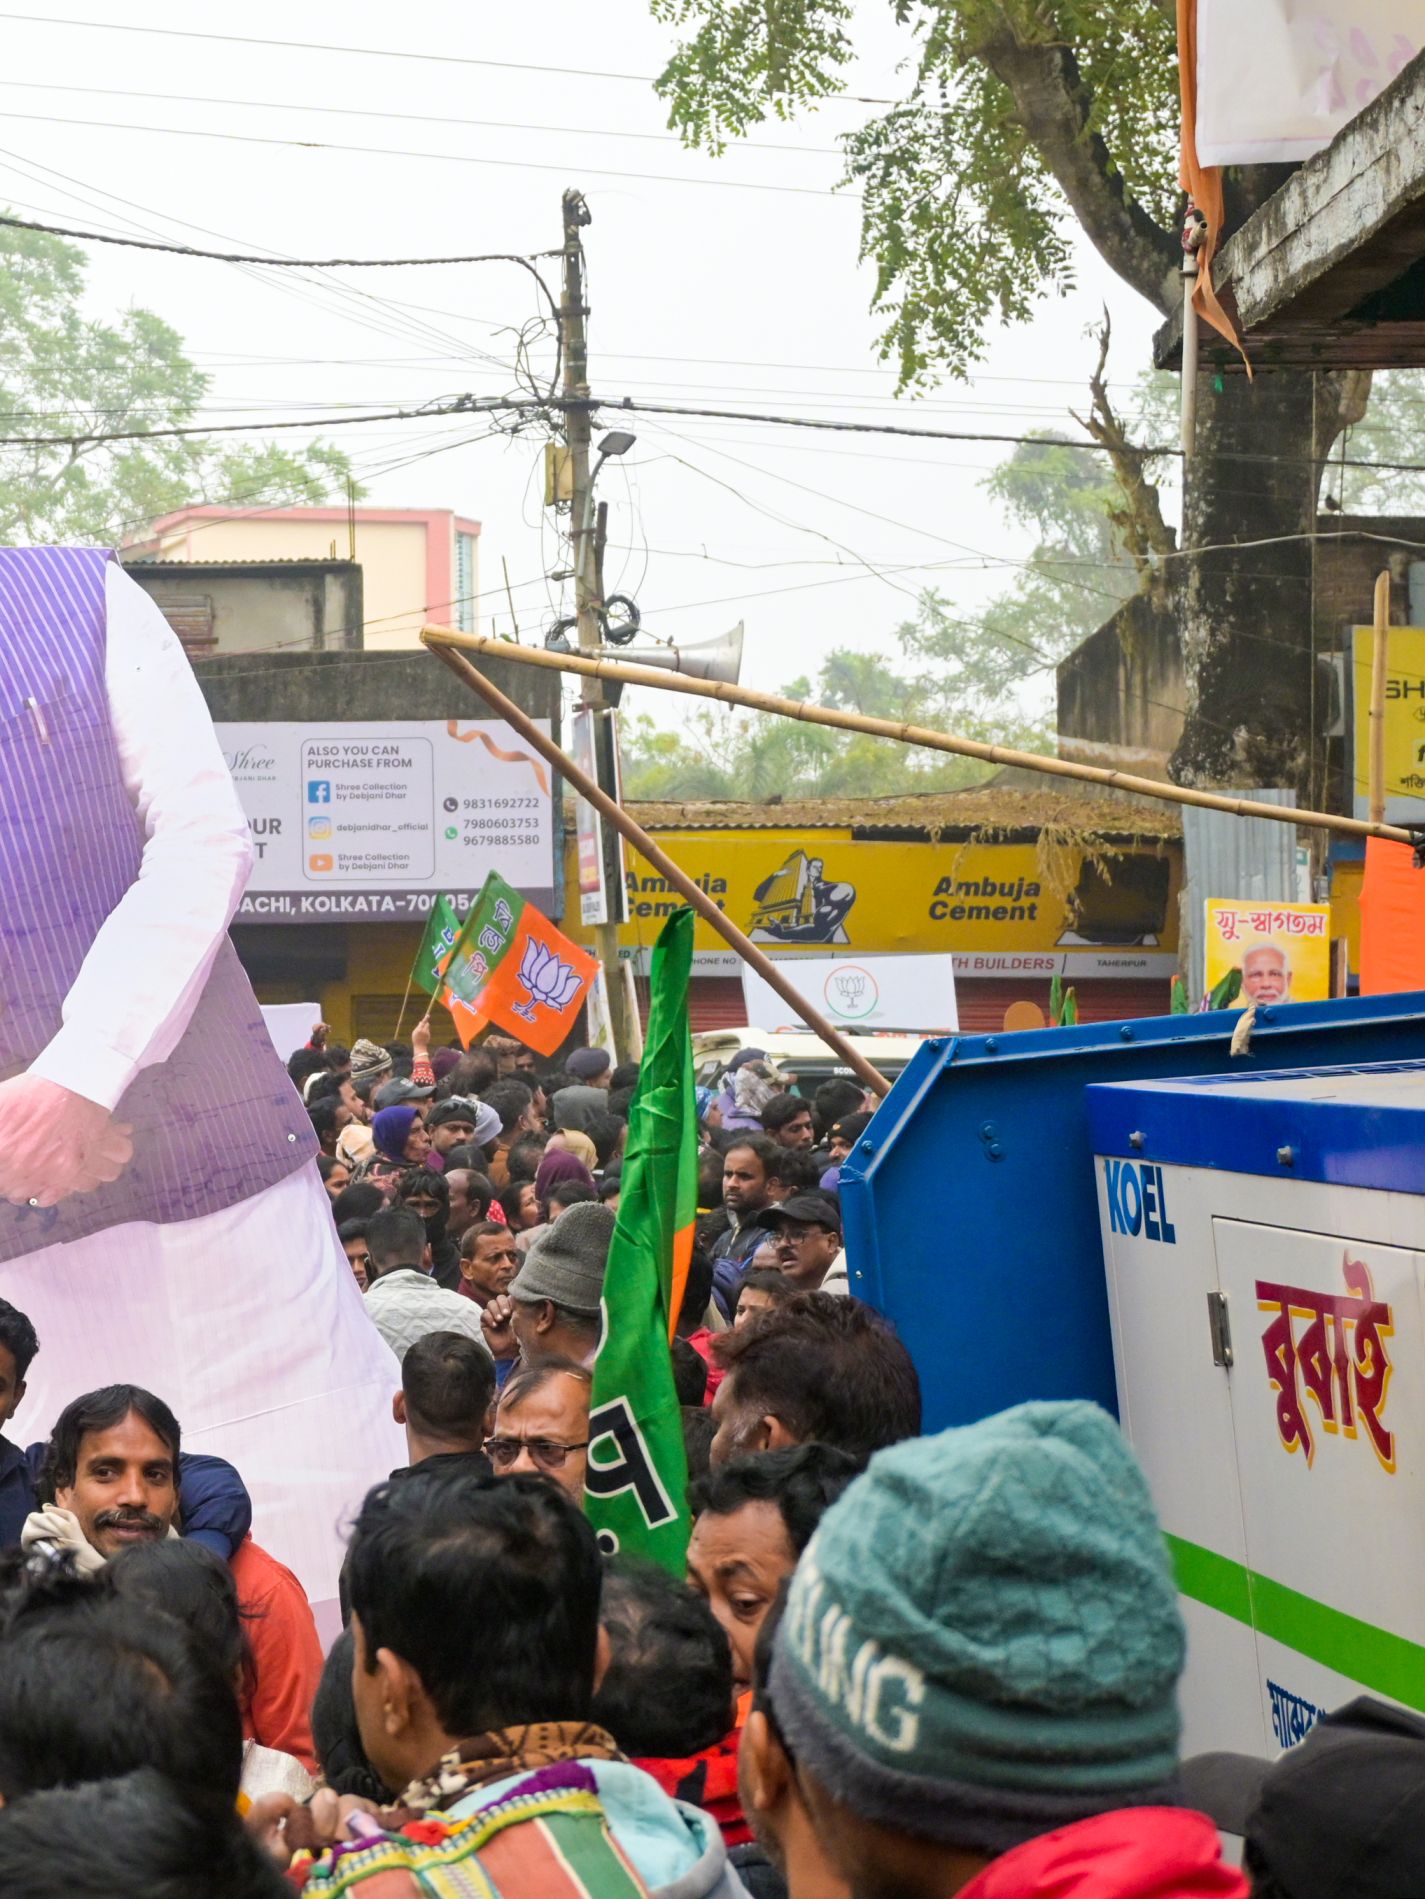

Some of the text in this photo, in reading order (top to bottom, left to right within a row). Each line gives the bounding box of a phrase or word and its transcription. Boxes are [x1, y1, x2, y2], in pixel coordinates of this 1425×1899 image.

[307, 746, 399, 756] ALSO YOU CAN
[307, 758, 413, 769] PURCHASE FROM
[335, 783, 407, 791] Shree Collection
[336, 792, 407, 801] by Debjani Dhar
[463, 798, 540, 809] 9831692722
[463, 818, 540, 829] 7980603753
[463, 835, 540, 846] 9679885580
[338, 853, 410, 862] Shree Collection
[339, 862, 409, 871] by Debjani Dhar
[933, 877, 1041, 901] Ambuja
[929, 901, 1038, 920] Cement
[974, 957, 1054, 969] BUILDERS
[1097, 959, 1147, 968] TAHERPUR
[1105, 1159, 1176, 1244] KOEL
